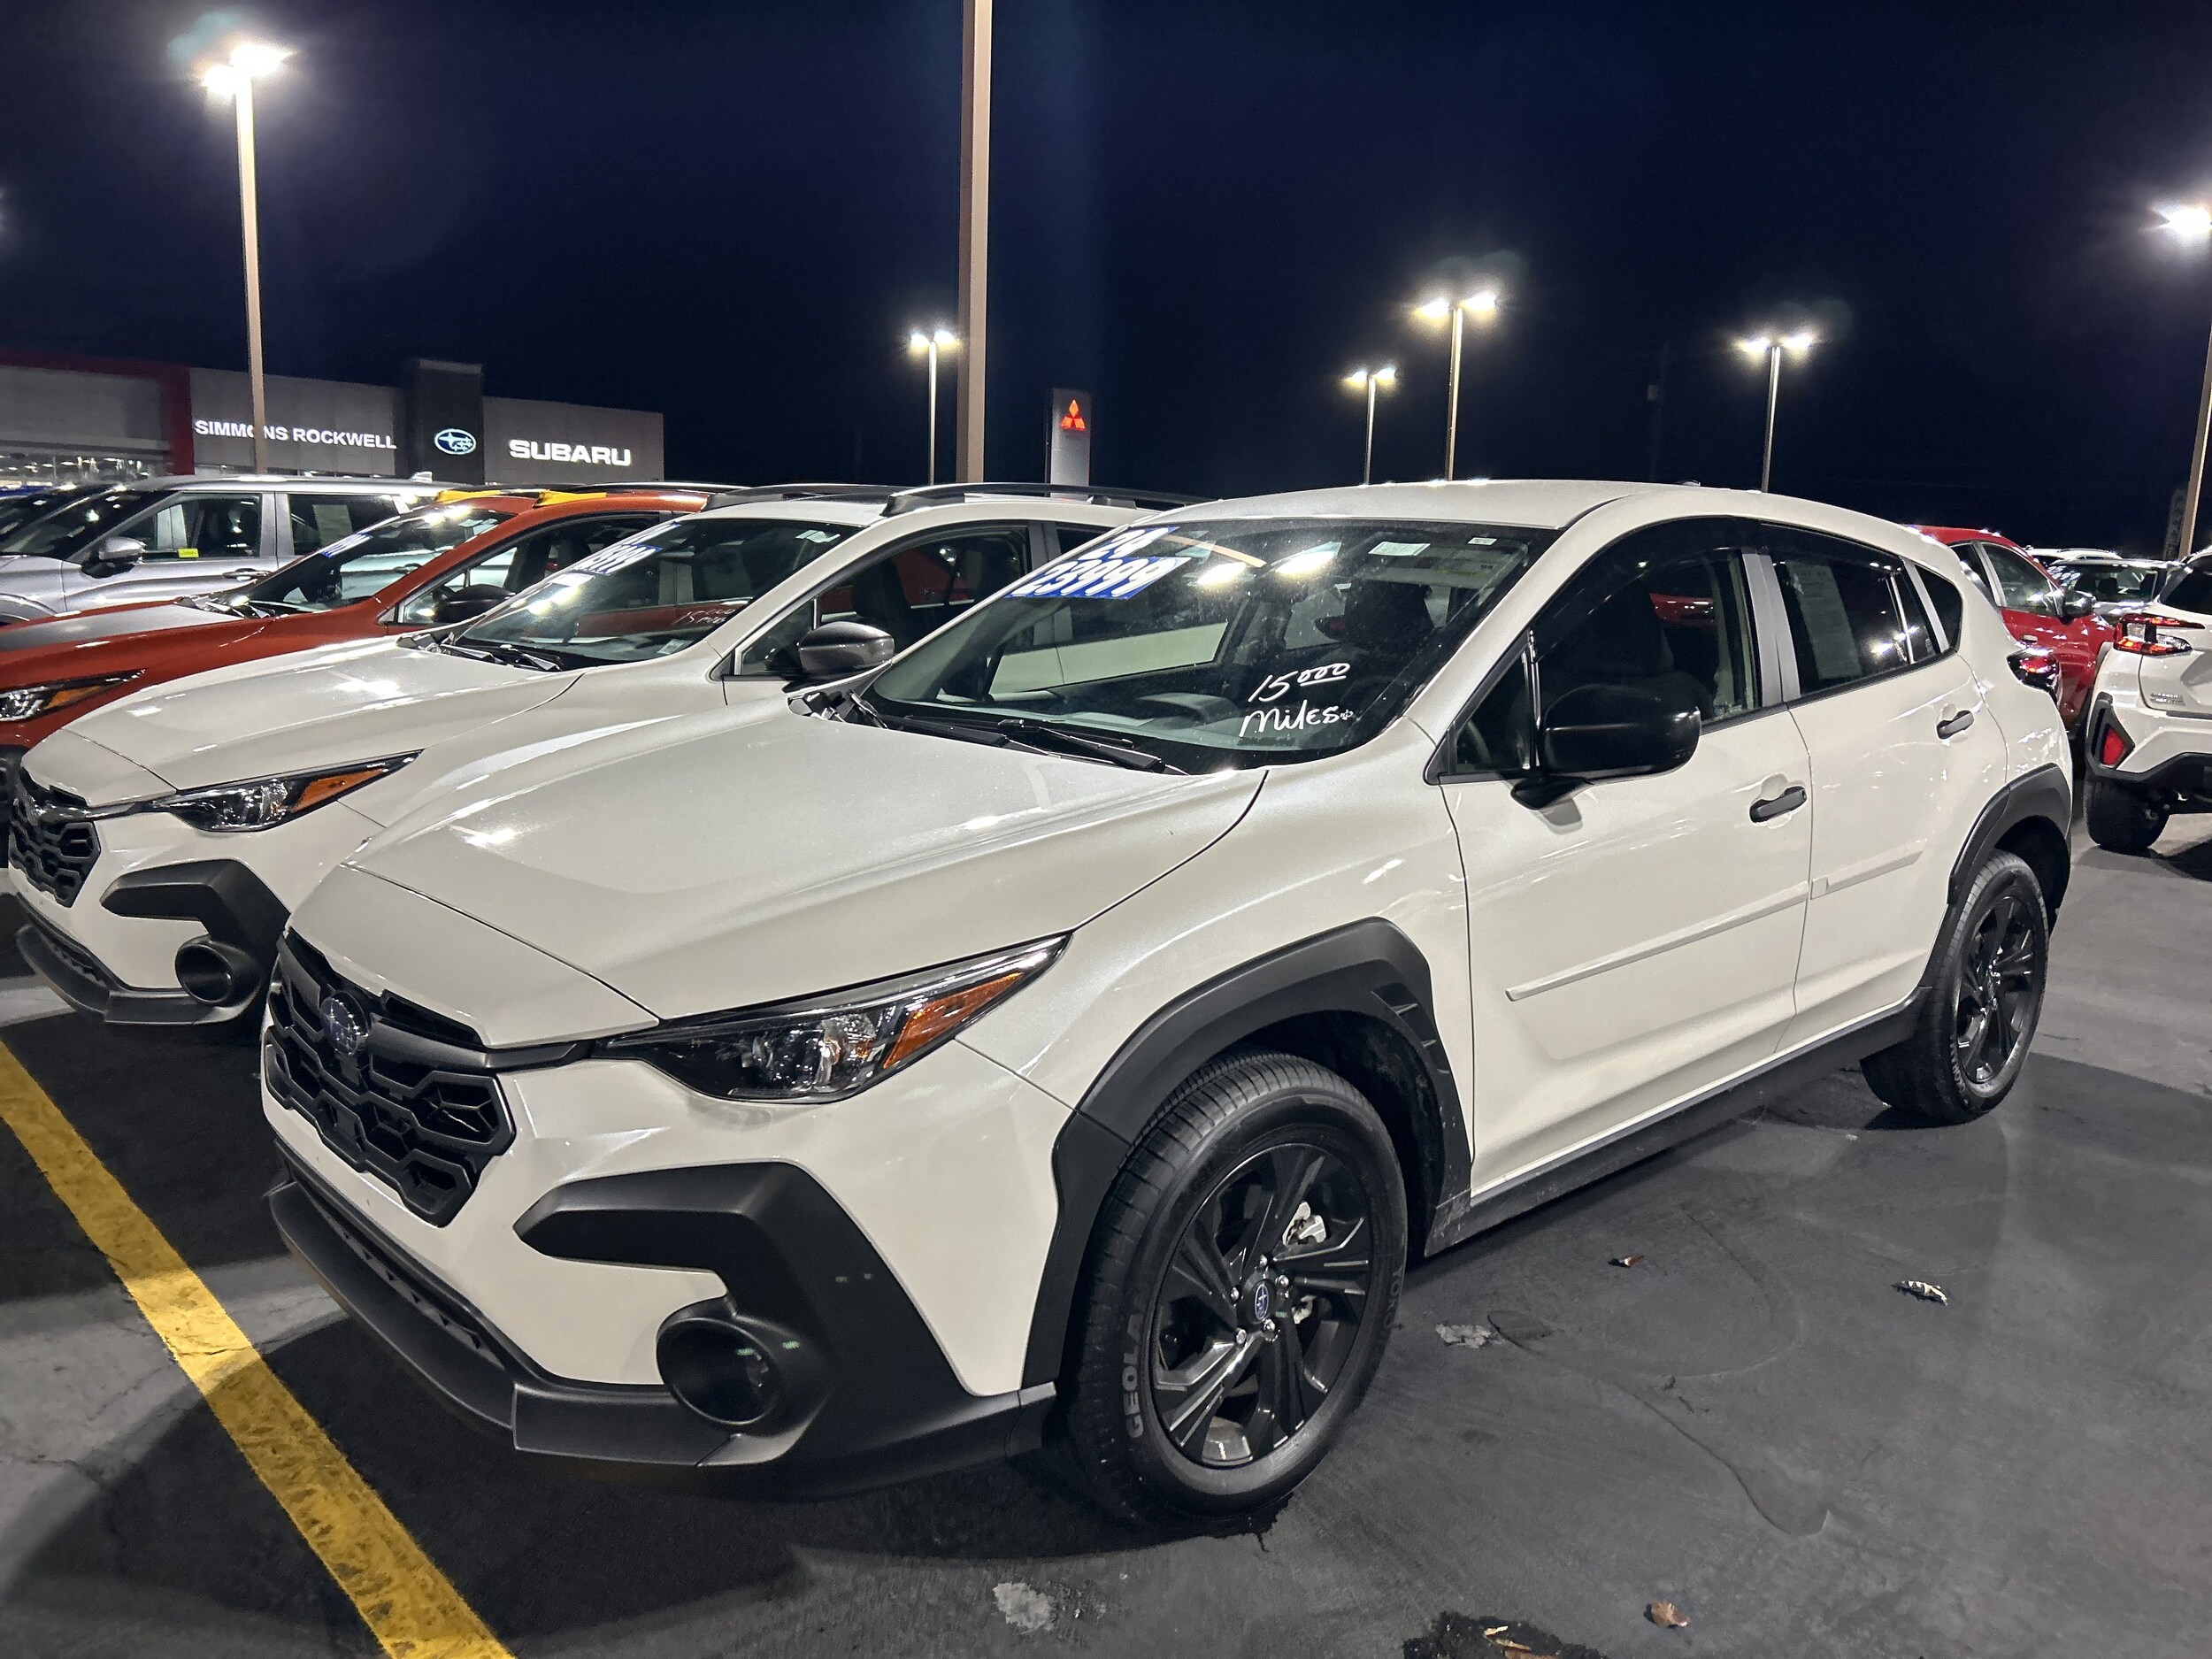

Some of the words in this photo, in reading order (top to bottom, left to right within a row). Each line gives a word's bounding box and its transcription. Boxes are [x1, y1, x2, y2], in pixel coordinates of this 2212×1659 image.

[292, 427, 397, 449] ROCKWELL
[509, 439, 632, 466] SUBARU
[1011, 558, 1178, 597] 23999
